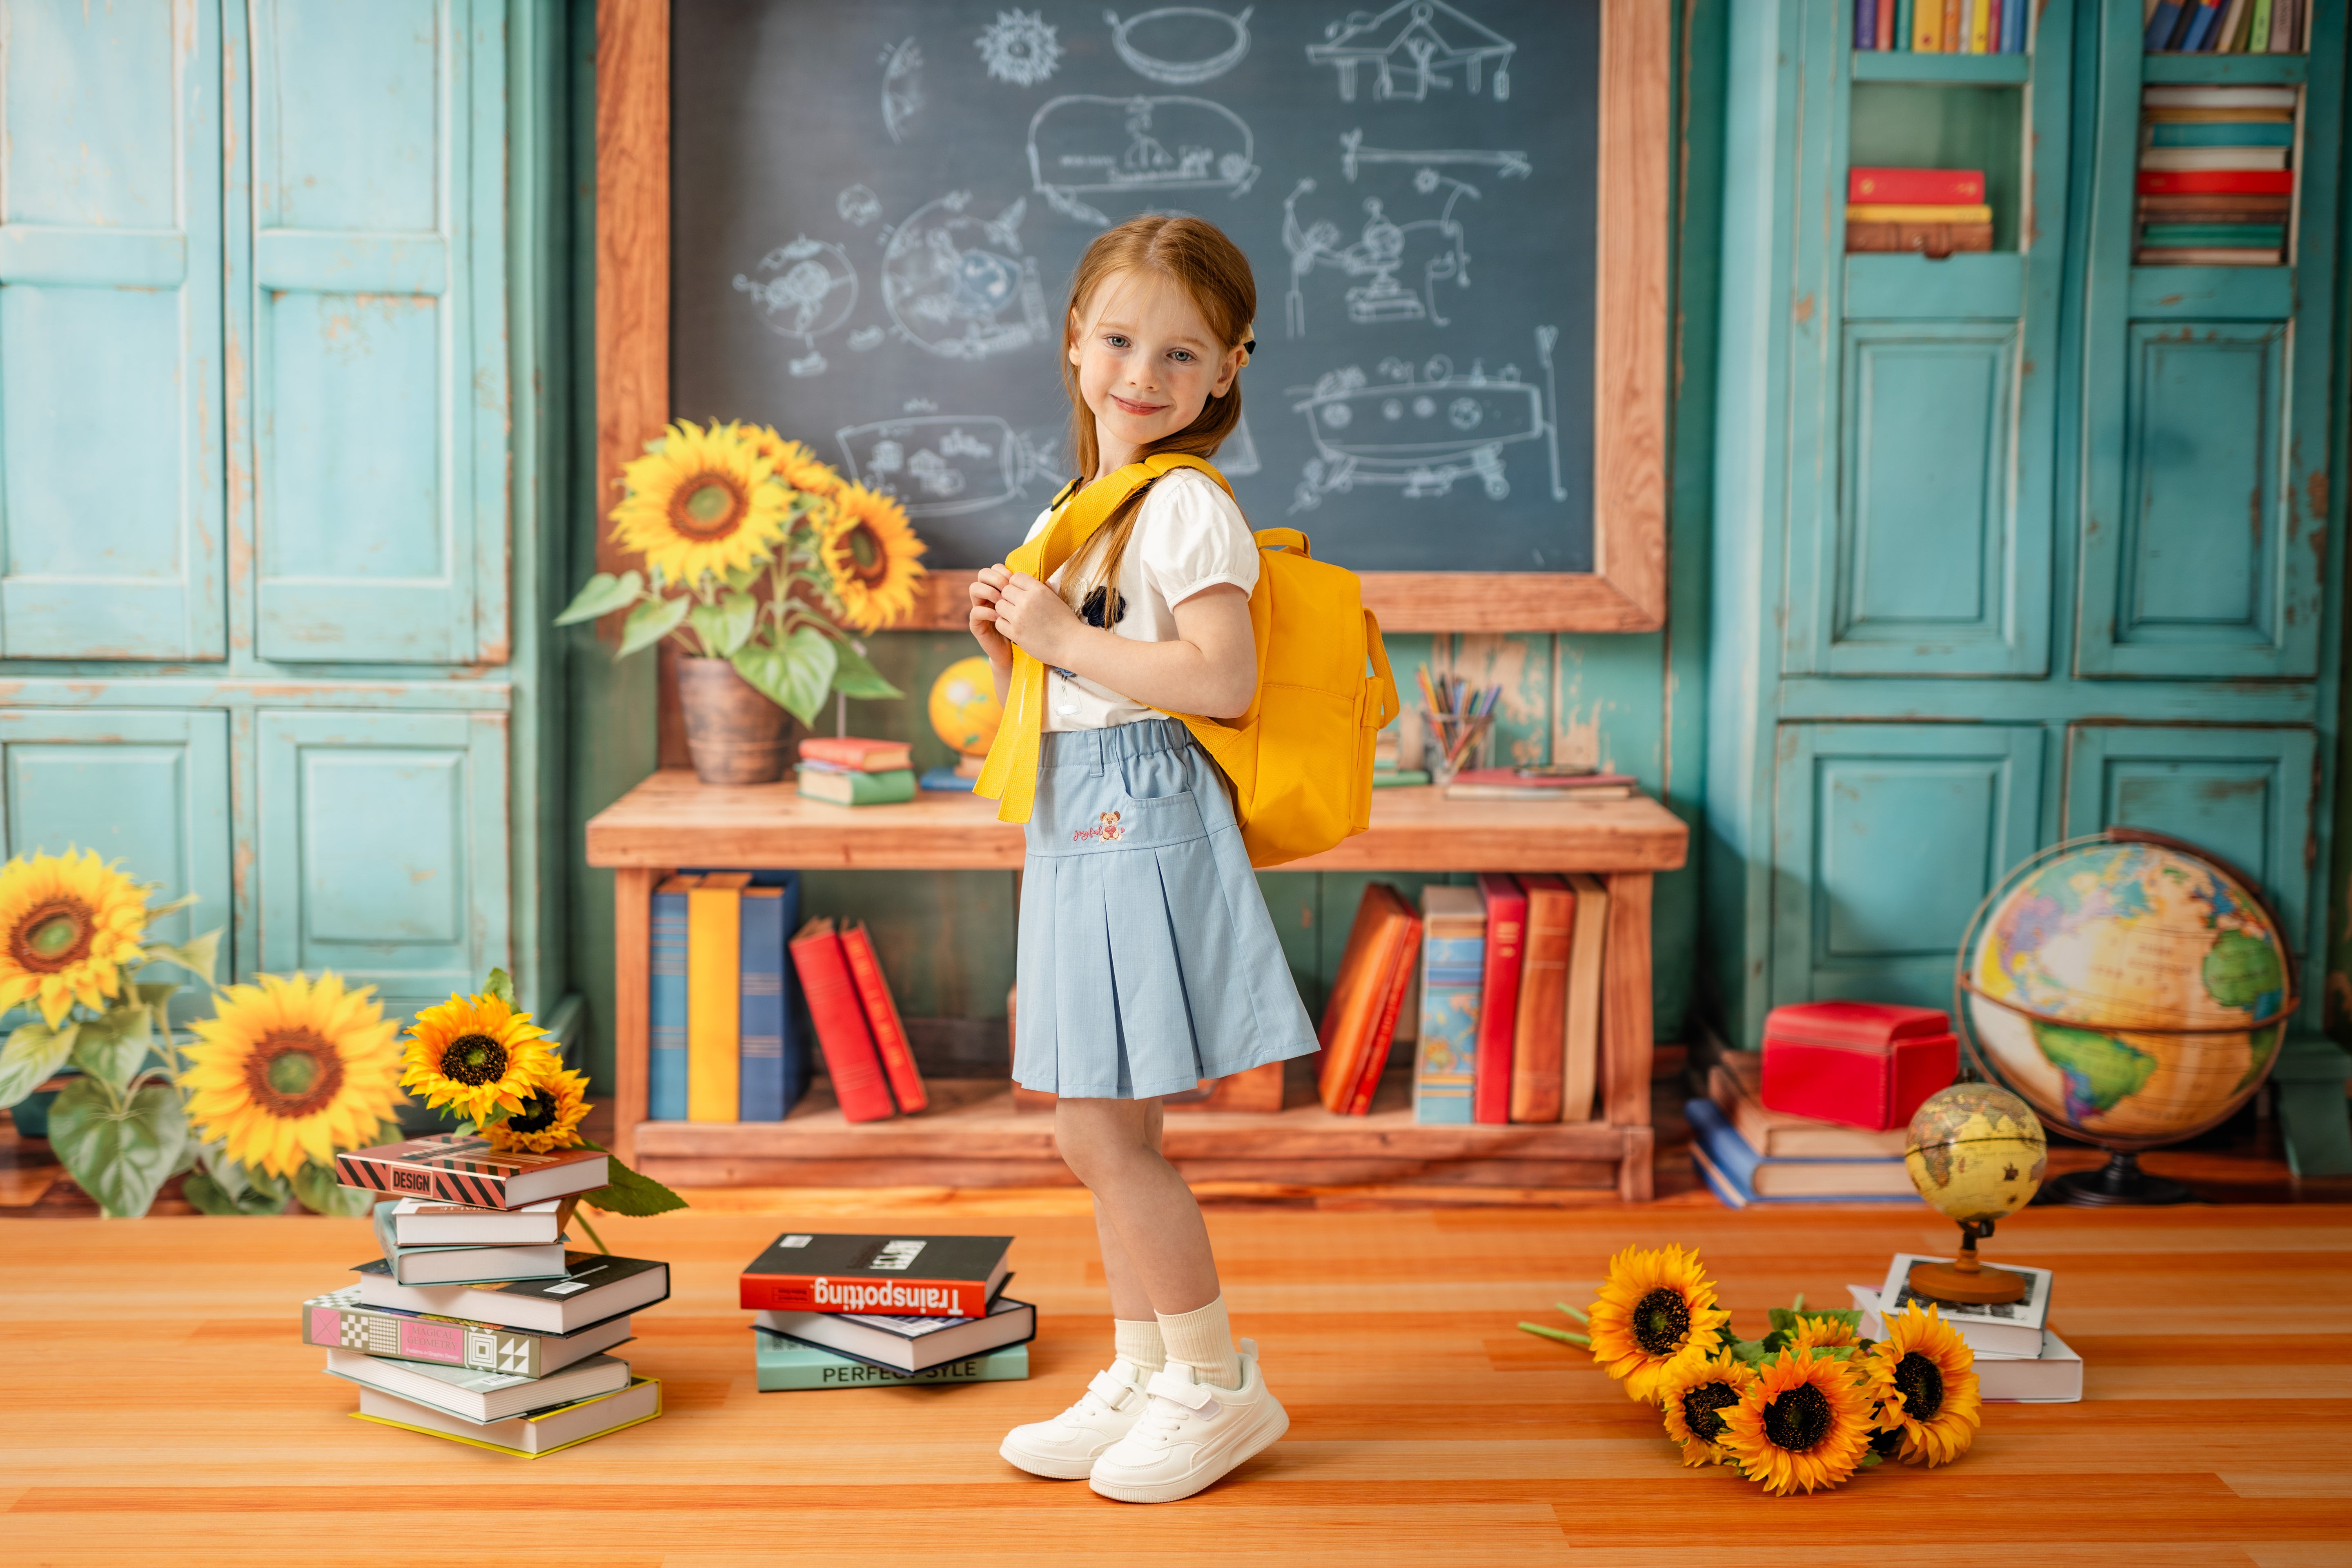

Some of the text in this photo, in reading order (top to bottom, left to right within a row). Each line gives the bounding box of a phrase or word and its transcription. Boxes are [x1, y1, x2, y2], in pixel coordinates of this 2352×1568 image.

[1073, 825, 1103, 841] joyful
[393, 1171, 430, 1192] DESIGN
[814, 1277, 964, 1316] Trainspotting
[412, 1326, 454, 1340] MAGICAL
[407, 1336, 458, 1350] GEOMETRY
[823, 1365, 916, 1383] PERFEC
